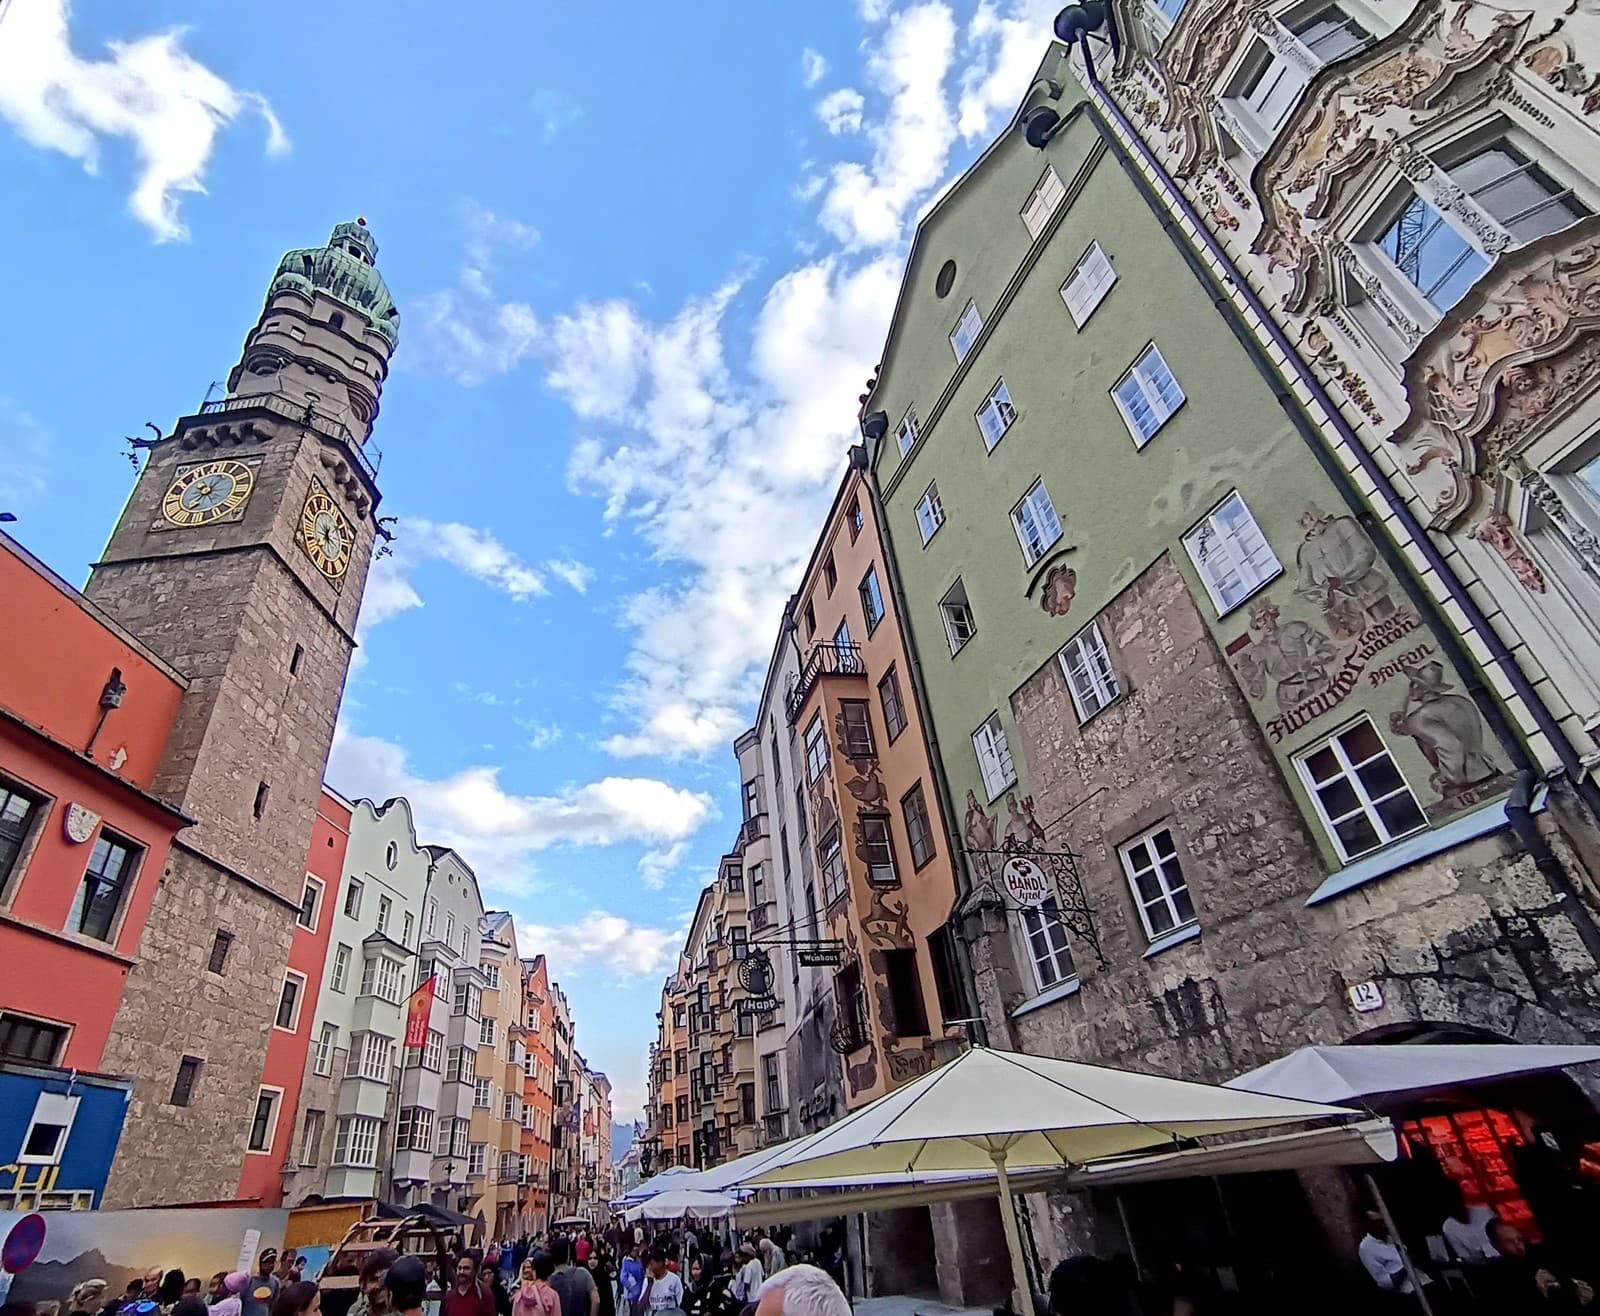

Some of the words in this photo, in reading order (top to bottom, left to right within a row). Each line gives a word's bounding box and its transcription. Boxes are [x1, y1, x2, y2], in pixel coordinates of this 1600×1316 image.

[1360, 619, 1421, 660] waren
[803, 952, 838, 962] Weinhaus
[1356, 984, 1374, 1002] 12
[748, 998, 776, 1010] Happ
